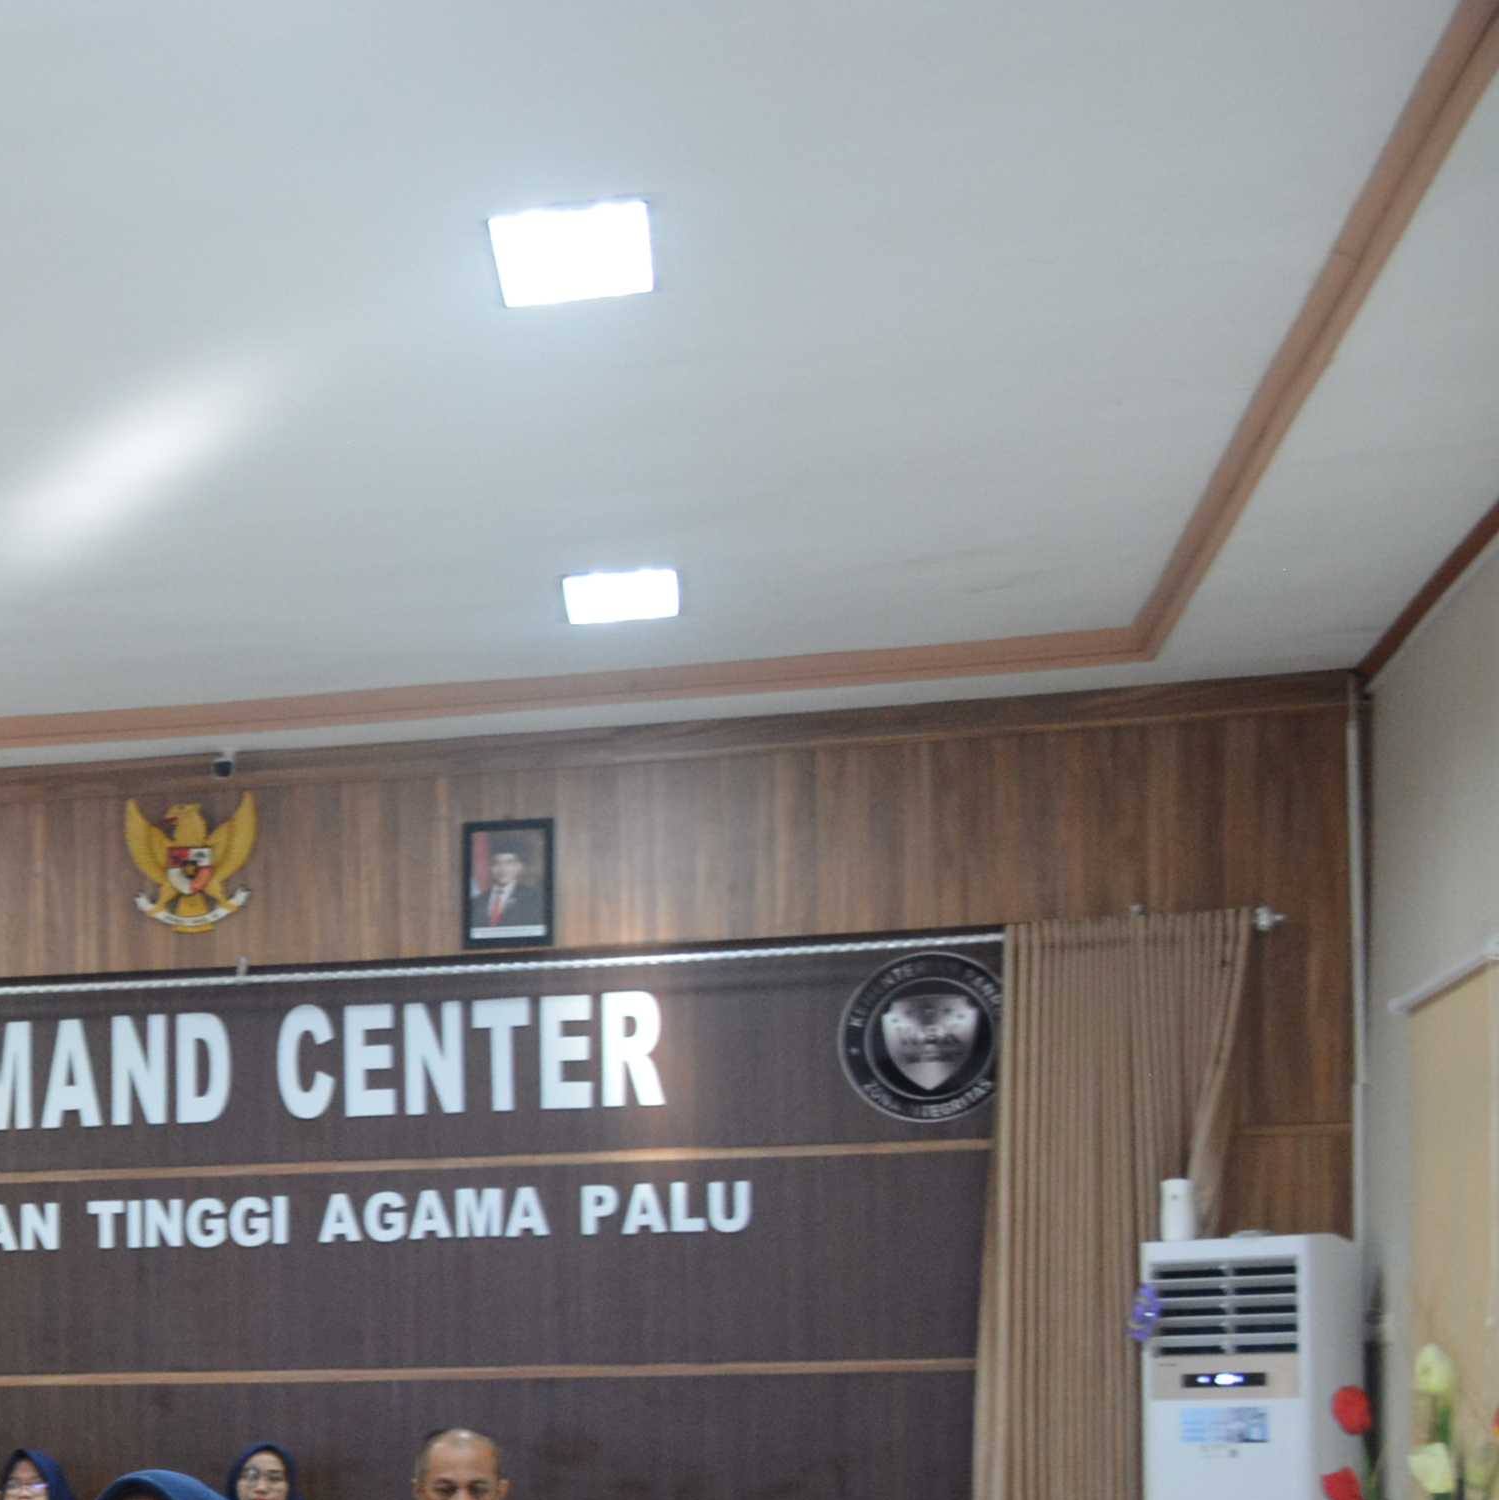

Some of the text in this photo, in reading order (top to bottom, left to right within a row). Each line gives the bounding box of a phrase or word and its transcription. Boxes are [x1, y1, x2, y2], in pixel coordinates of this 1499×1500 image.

[277, 990, 667, 1120] CENTER
[88, 1195, 289, 1250] TINGGI
[318, 1186, 550, 1243] AGAMA
[580, 1180, 752, 1236] PALU
